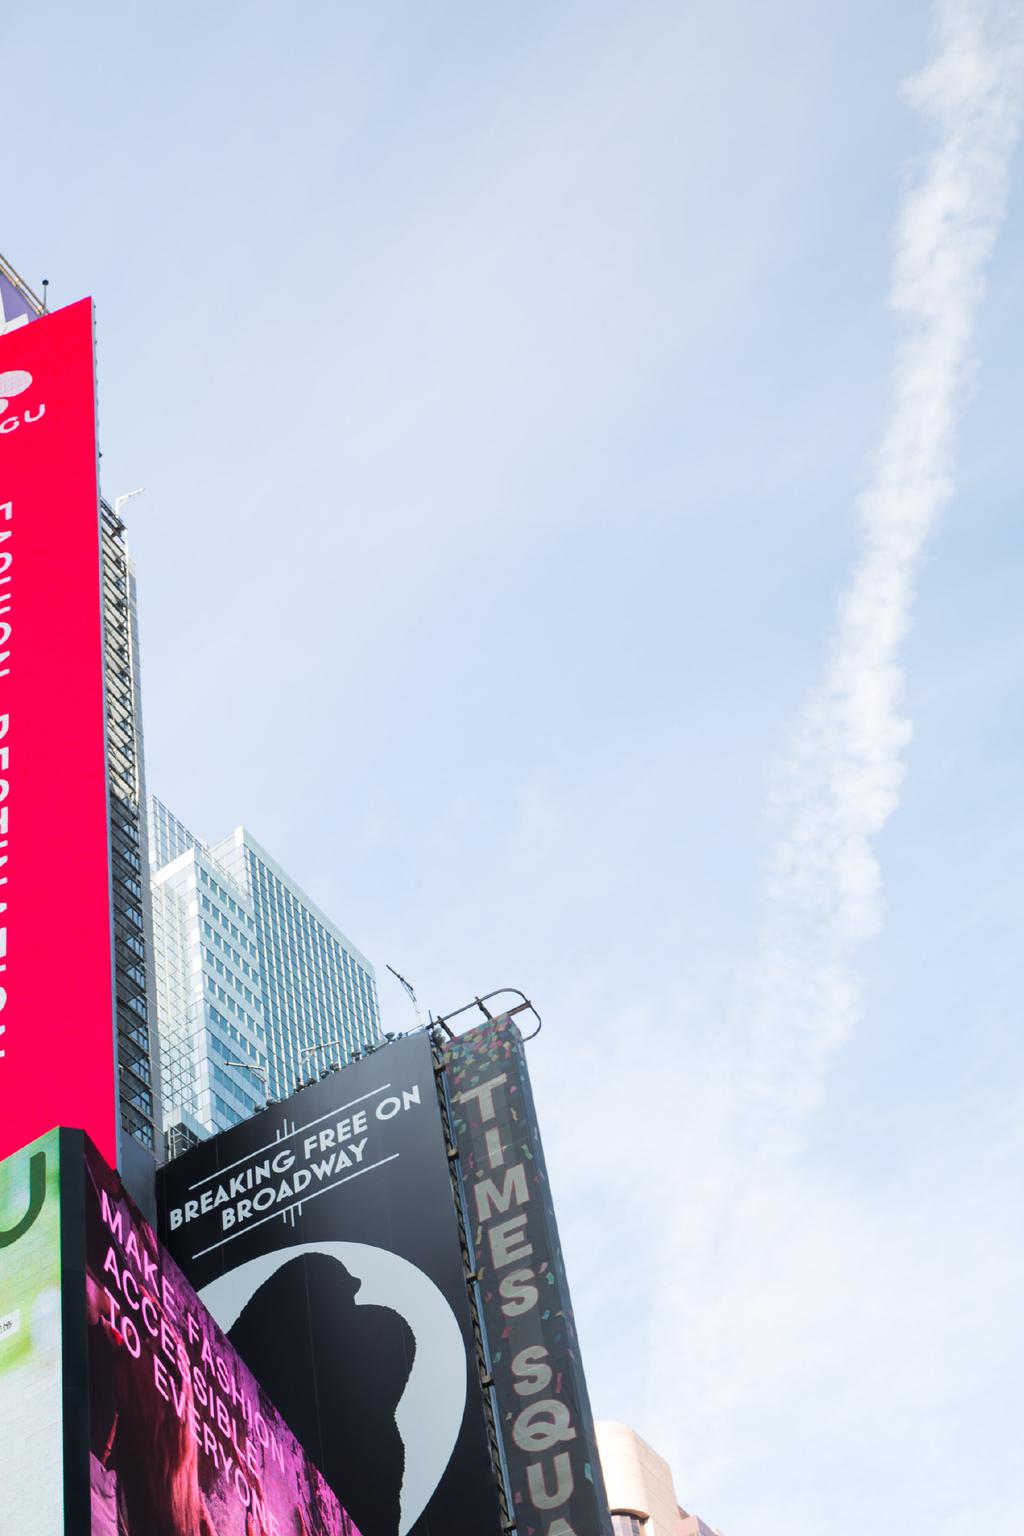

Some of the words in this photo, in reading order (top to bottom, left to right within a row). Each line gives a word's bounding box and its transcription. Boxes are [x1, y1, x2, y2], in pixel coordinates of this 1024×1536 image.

[169, 1150, 296, 1230] BREAKING
[303, 1110, 368, 1158] FREE
[376, 1085, 422, 1122] ON
[221, 1139, 370, 1231] BROADWAY
[459, 1072, 540, 1318] TIMES
[101, 1188, 179, 1318] MAKE
[187, 1311, 286, 1473] FASHION
[103, 1286, 141, 1358] TO
[103, 1246, 261, 1482] ACCESSIBLE
